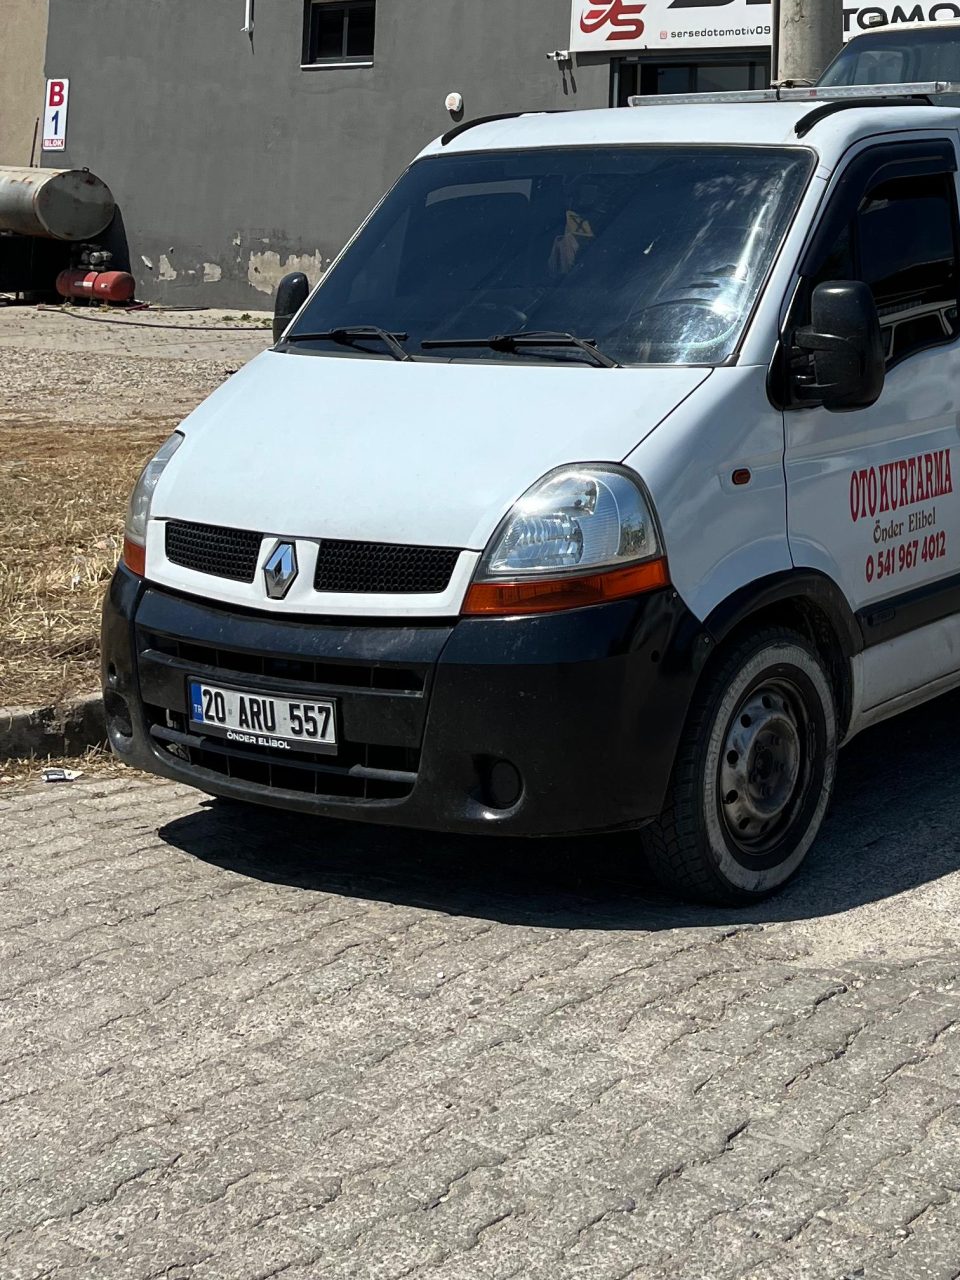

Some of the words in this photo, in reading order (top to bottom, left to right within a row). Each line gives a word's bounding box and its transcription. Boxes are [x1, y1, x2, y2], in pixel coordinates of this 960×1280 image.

[670, 25, 772, 39] sersedotomotiv09
[49, 82, 64, 106] B
[52, 111, 59, 135] 1
[850, 466, 878, 522] OTO
[878, 448, 953, 513] KURTARMA
[873, 519, 904, 544] Önder
[908, 506, 936, 533] Elibol
[865, 554, 874, 583] 0
[877, 547, 896, 579] 541
[898, 540, 919, 573] 967
[921, 530, 946, 563] 4012
[202, 688, 226, 723] 20
[239, 696, 276, 732] ARU
[288, 703, 331, 738] 557
